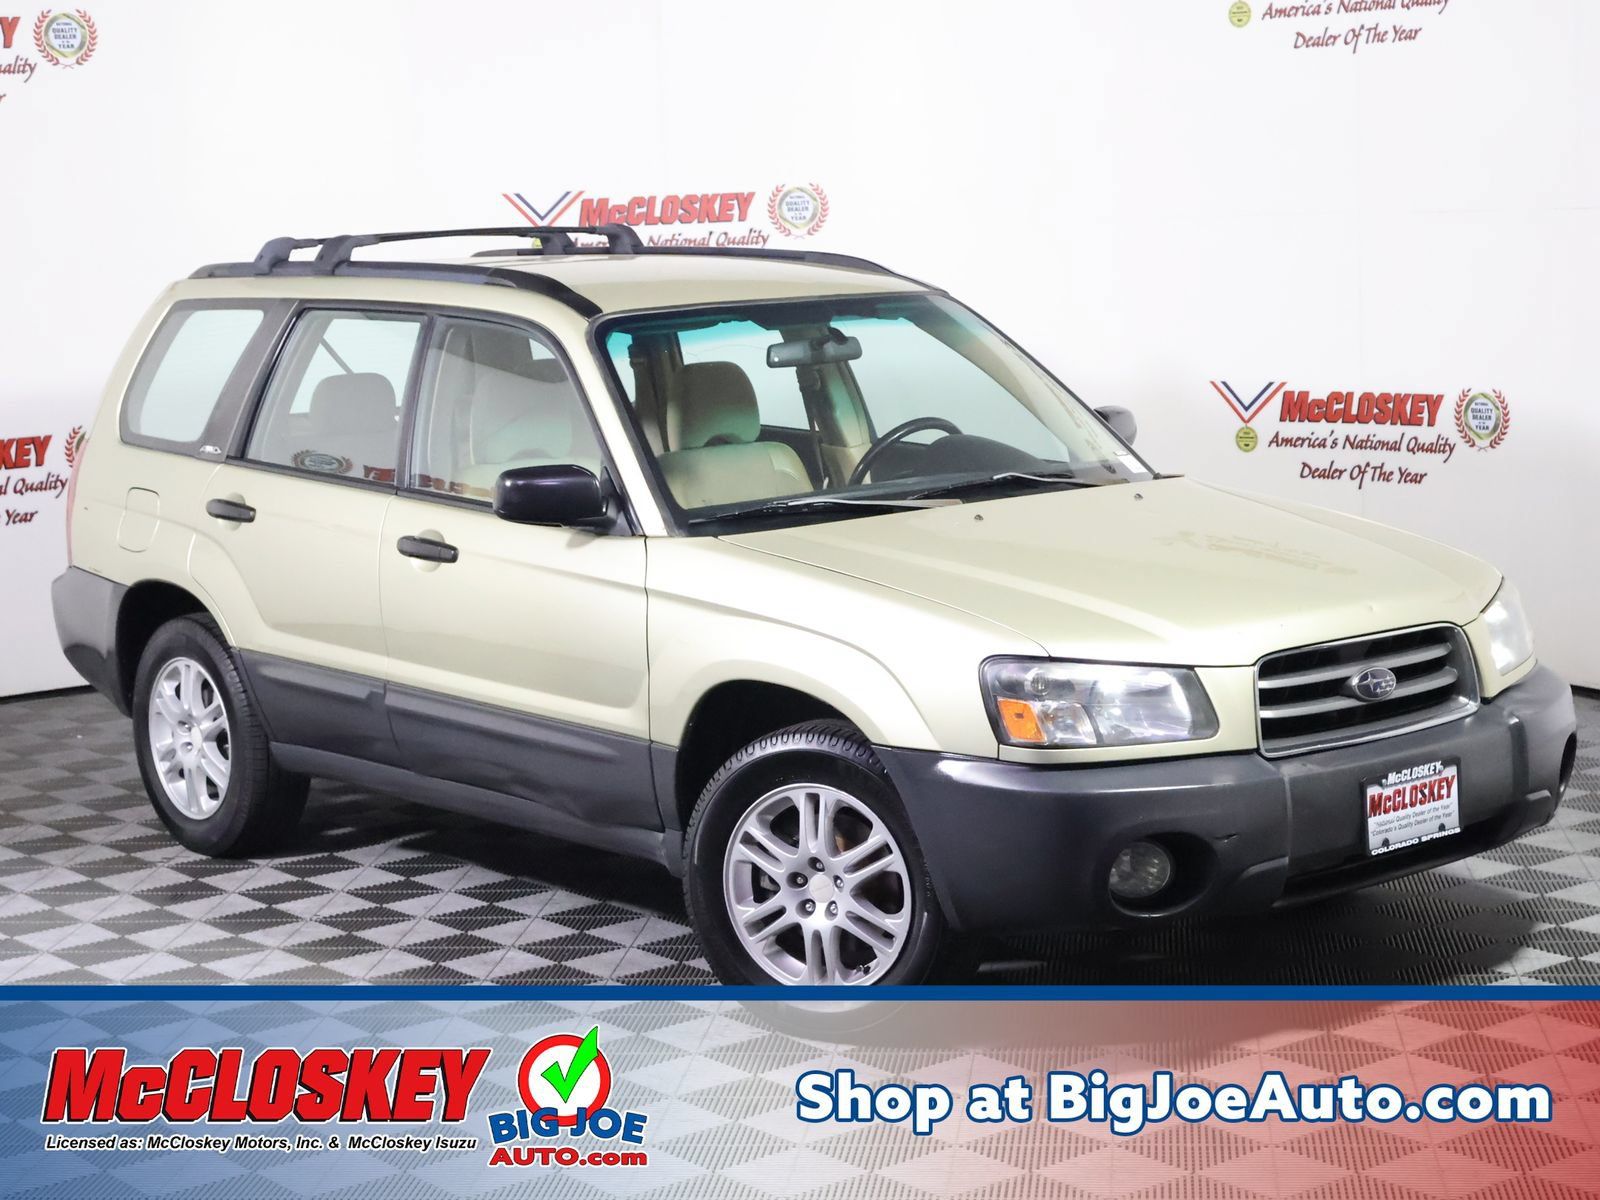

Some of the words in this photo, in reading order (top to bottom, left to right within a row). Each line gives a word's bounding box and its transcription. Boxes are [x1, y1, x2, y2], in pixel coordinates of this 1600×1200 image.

[1293, 26, 1342, 49] Dealer
[1343, 23, 1365, 54] Of
[1364, 22, 1389, 44] The
[1391, 24, 1423, 43] Year
[579, 191, 756, 228] McCLOSKEY
[647, 231, 713, 247] National
[715, 228, 770, 248] Quality
[1279, 390, 1444, 427] McCLOSKEY
[1267, 430, 1339, 448] America's
[1342, 432, 1405, 452] National
[1406, 434, 1457, 463] Quality
[13, 472, 68, 499] Quality
[1299, 460, 1347, 481] Dealer
[1349, 461, 1370, 490] Of
[1370, 462, 1394, 483] The
[1397, 466, 1428, 485] Year
[5, 508, 39, 526] Year
[1387, 760, 1442, 785] McCLOSKEY
[1368, 774, 1456, 818] McCLOSKEY
[1371, 838, 1419, 856] COLORADO
[1421, 827, 1461, 842] SPRINGS
